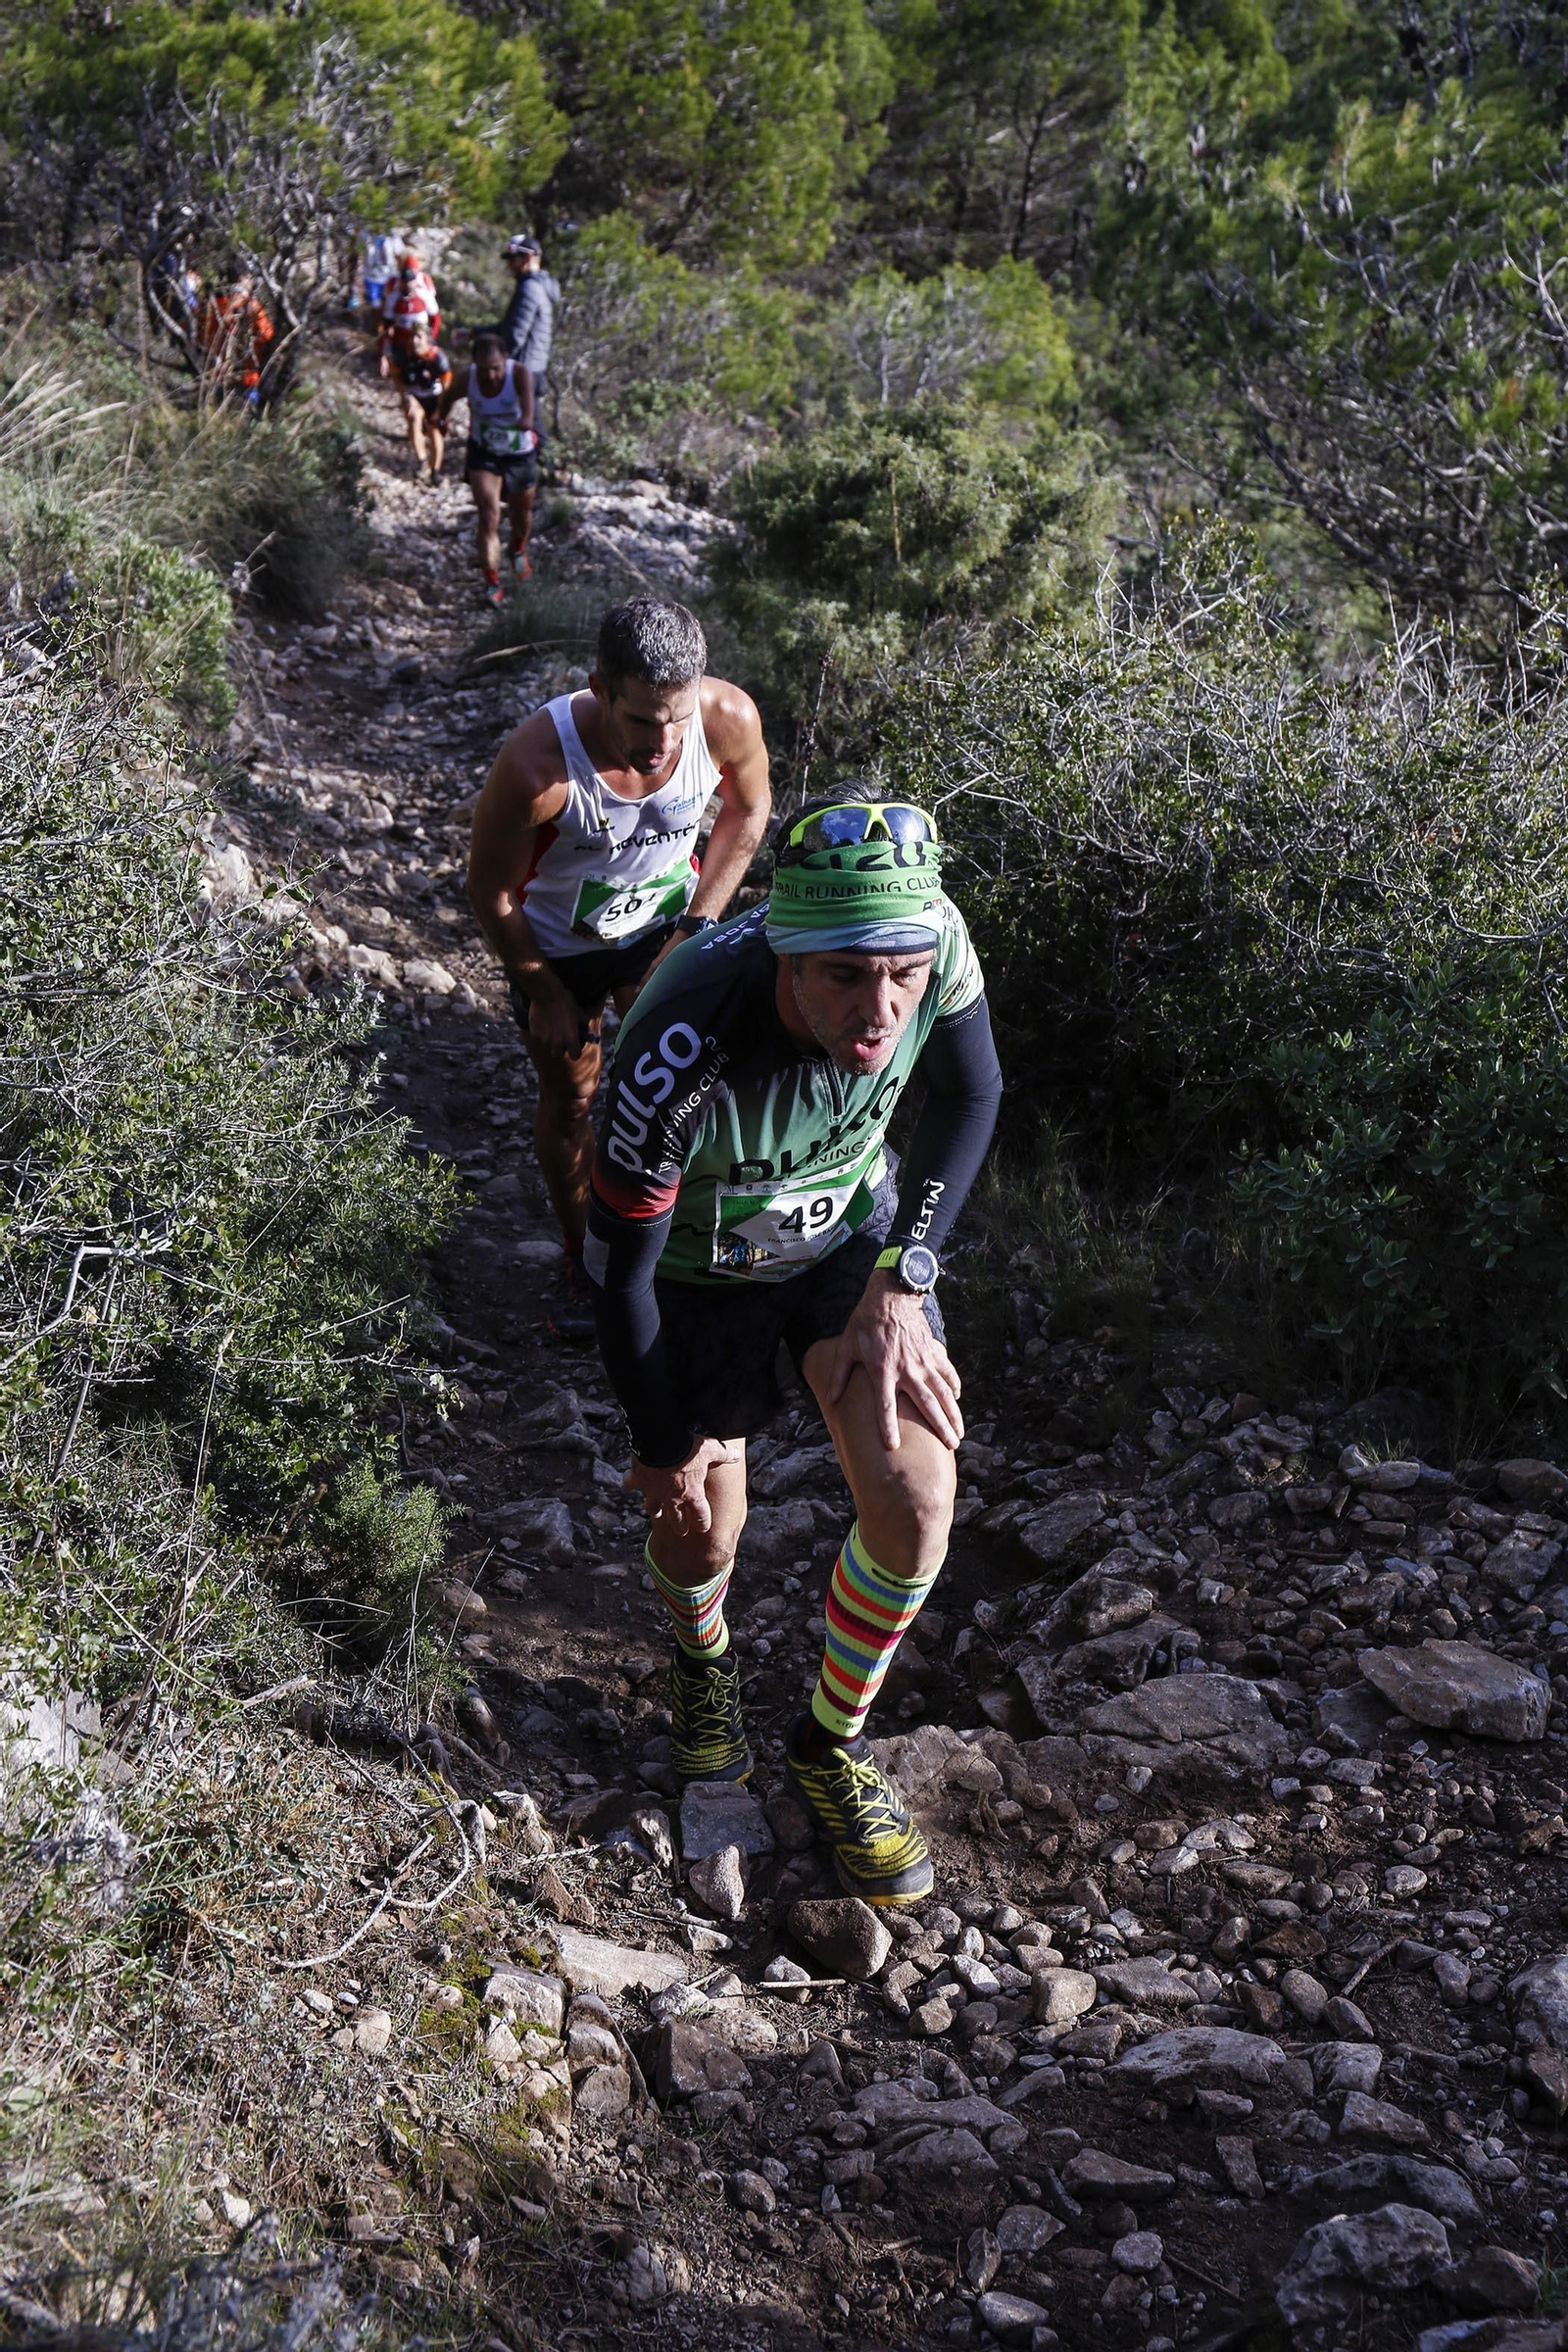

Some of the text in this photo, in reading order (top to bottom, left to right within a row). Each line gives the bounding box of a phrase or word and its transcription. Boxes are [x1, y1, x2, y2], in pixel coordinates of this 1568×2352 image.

[610, 822, 697, 856] REVENTÓ
[805, 881, 902, 900] RUNNING
[906, 876, 940, 892] CLUB
[699, 1052, 729, 1092] CLUB
[778, 1197, 833, 1234] 49
[911, 1180, 945, 1241] ELTIN
